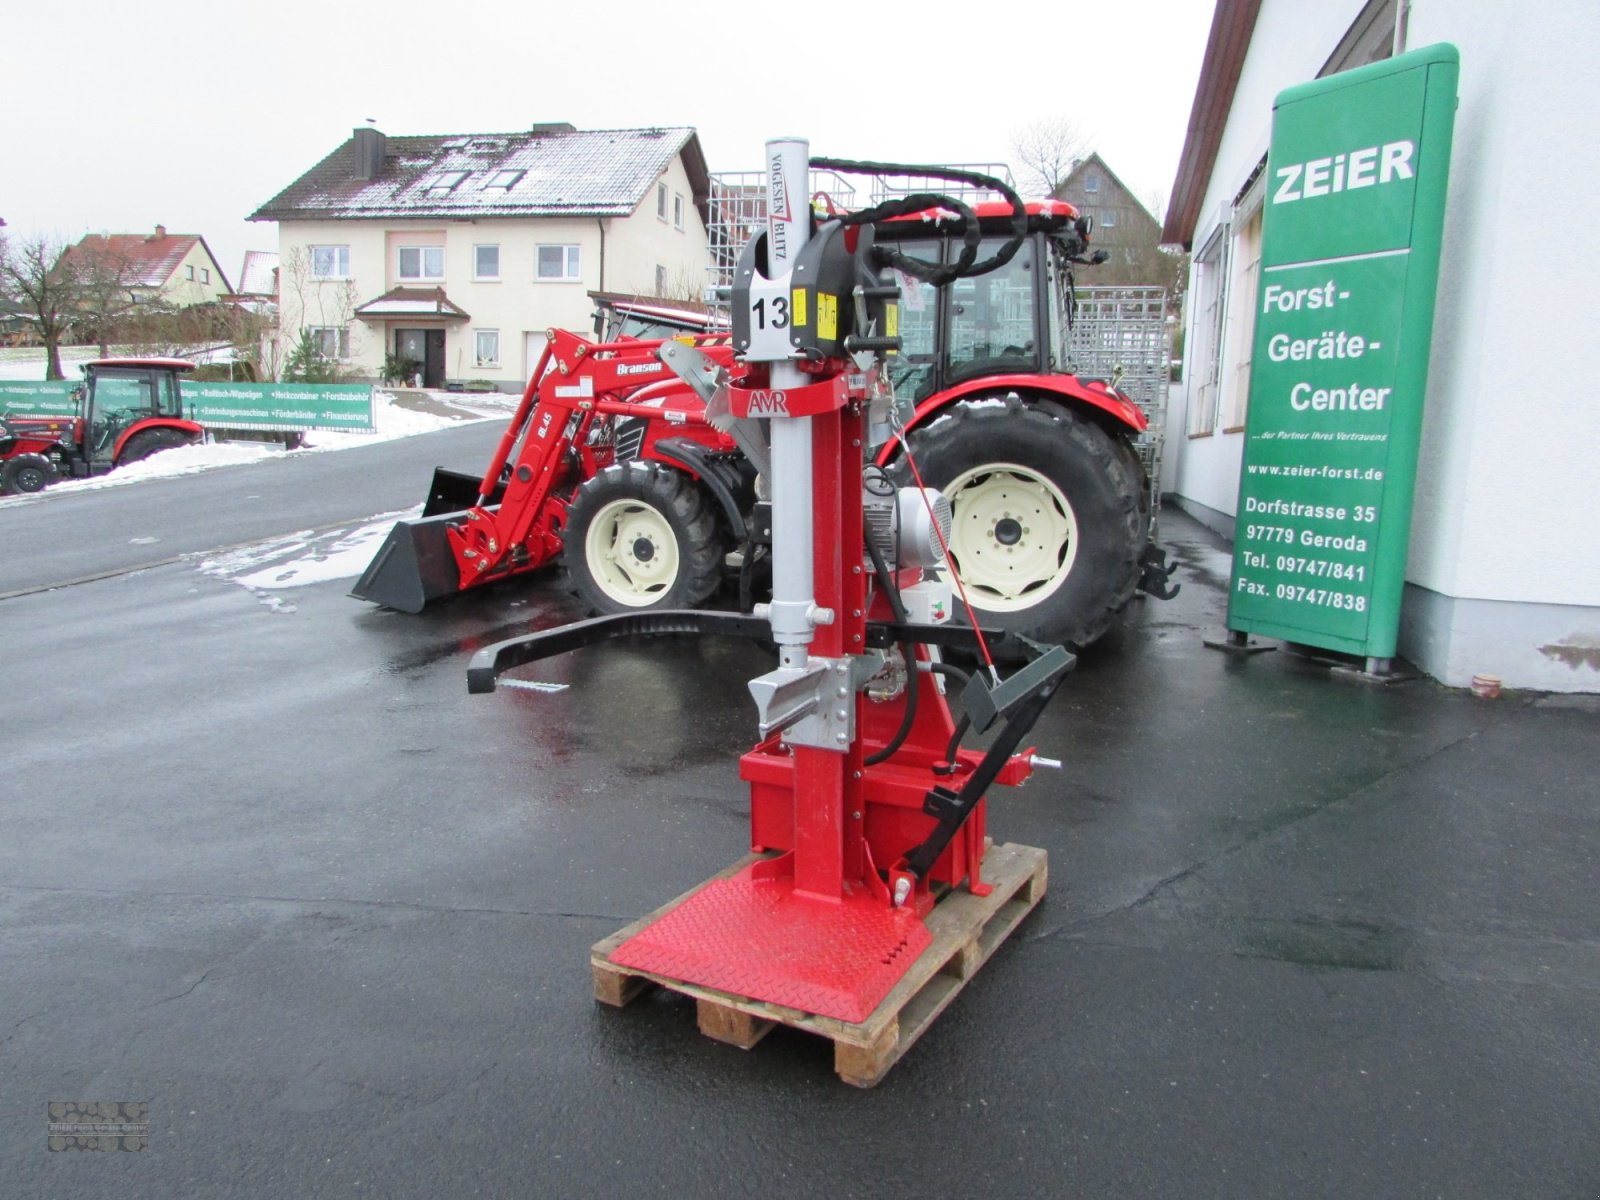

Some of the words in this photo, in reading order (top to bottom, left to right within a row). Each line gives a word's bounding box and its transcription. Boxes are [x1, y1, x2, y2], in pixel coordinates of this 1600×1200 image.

[772, 154, 784, 214] VOGESEN
[774, 222, 787, 261] BLITZ
[752, 296, 789, 329] 13
[617, 362, 662, 376] Branson
[748, 391, 786, 413] AMR
[1290, 382, 1391, 411] Center
[1277, 430, 1309, 440] Partner
[1311, 431, 1333, 440] Ihres
[1336, 432, 1388, 442] Vertrauens
[1247, 465, 1383, 481] www.zeier-forst.de
[1246, 497, 1347, 521] Dorfstrasse
[1353, 505, 1376, 523] 35
[1246, 525, 1294, 544] 97779
[1300, 530, 1367, 552] Geroda
[1243, 551, 1270, 569] Tel.
[1276, 556, 1365, 582] 09747/841
[1237, 577, 1270, 596] Fax.
[1276, 584, 1366, 612] 09747/838
